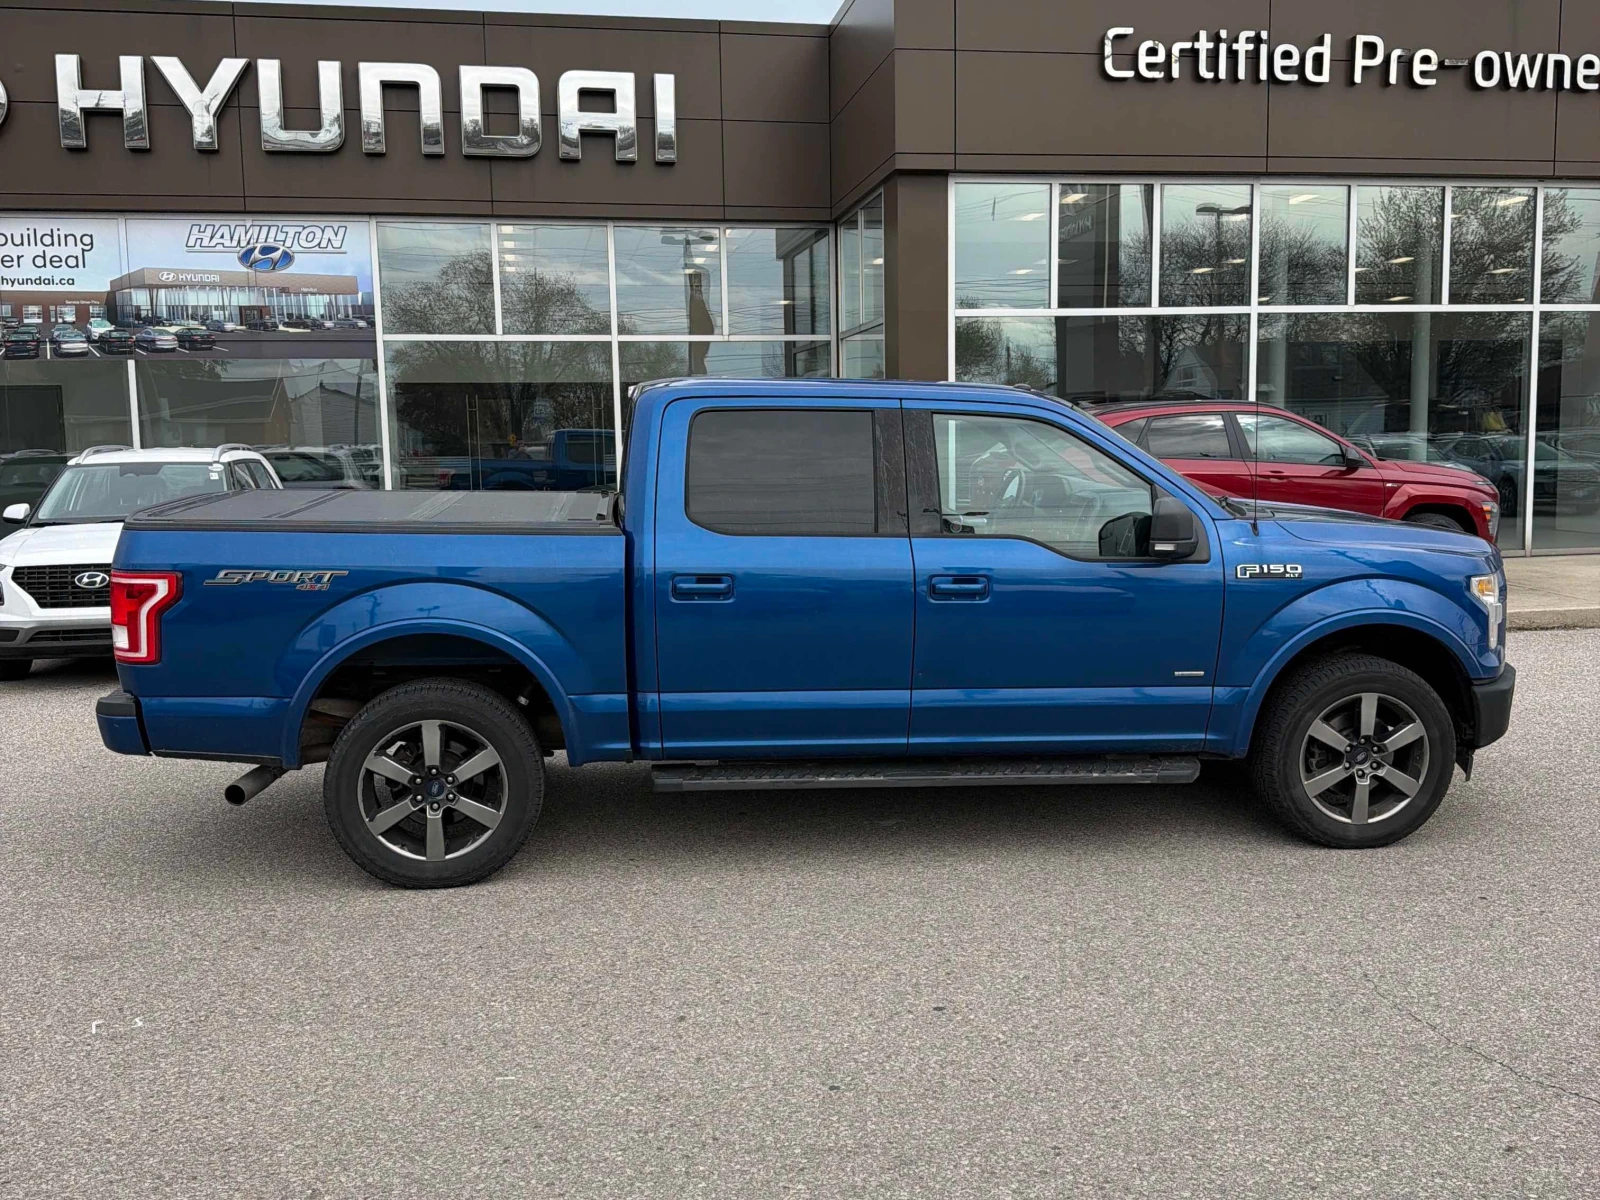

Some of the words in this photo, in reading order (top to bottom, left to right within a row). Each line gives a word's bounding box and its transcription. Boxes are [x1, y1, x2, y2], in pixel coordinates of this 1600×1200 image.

[1103, 26, 1332, 83] Certified
[54, 53, 677, 164] HYUNDAI
[186, 223, 348, 250] HAMILTON
[32, 249, 87, 269] deal
[178, 273, 220, 283] HYUNDAI
[203, 569, 349, 586] SPORT
